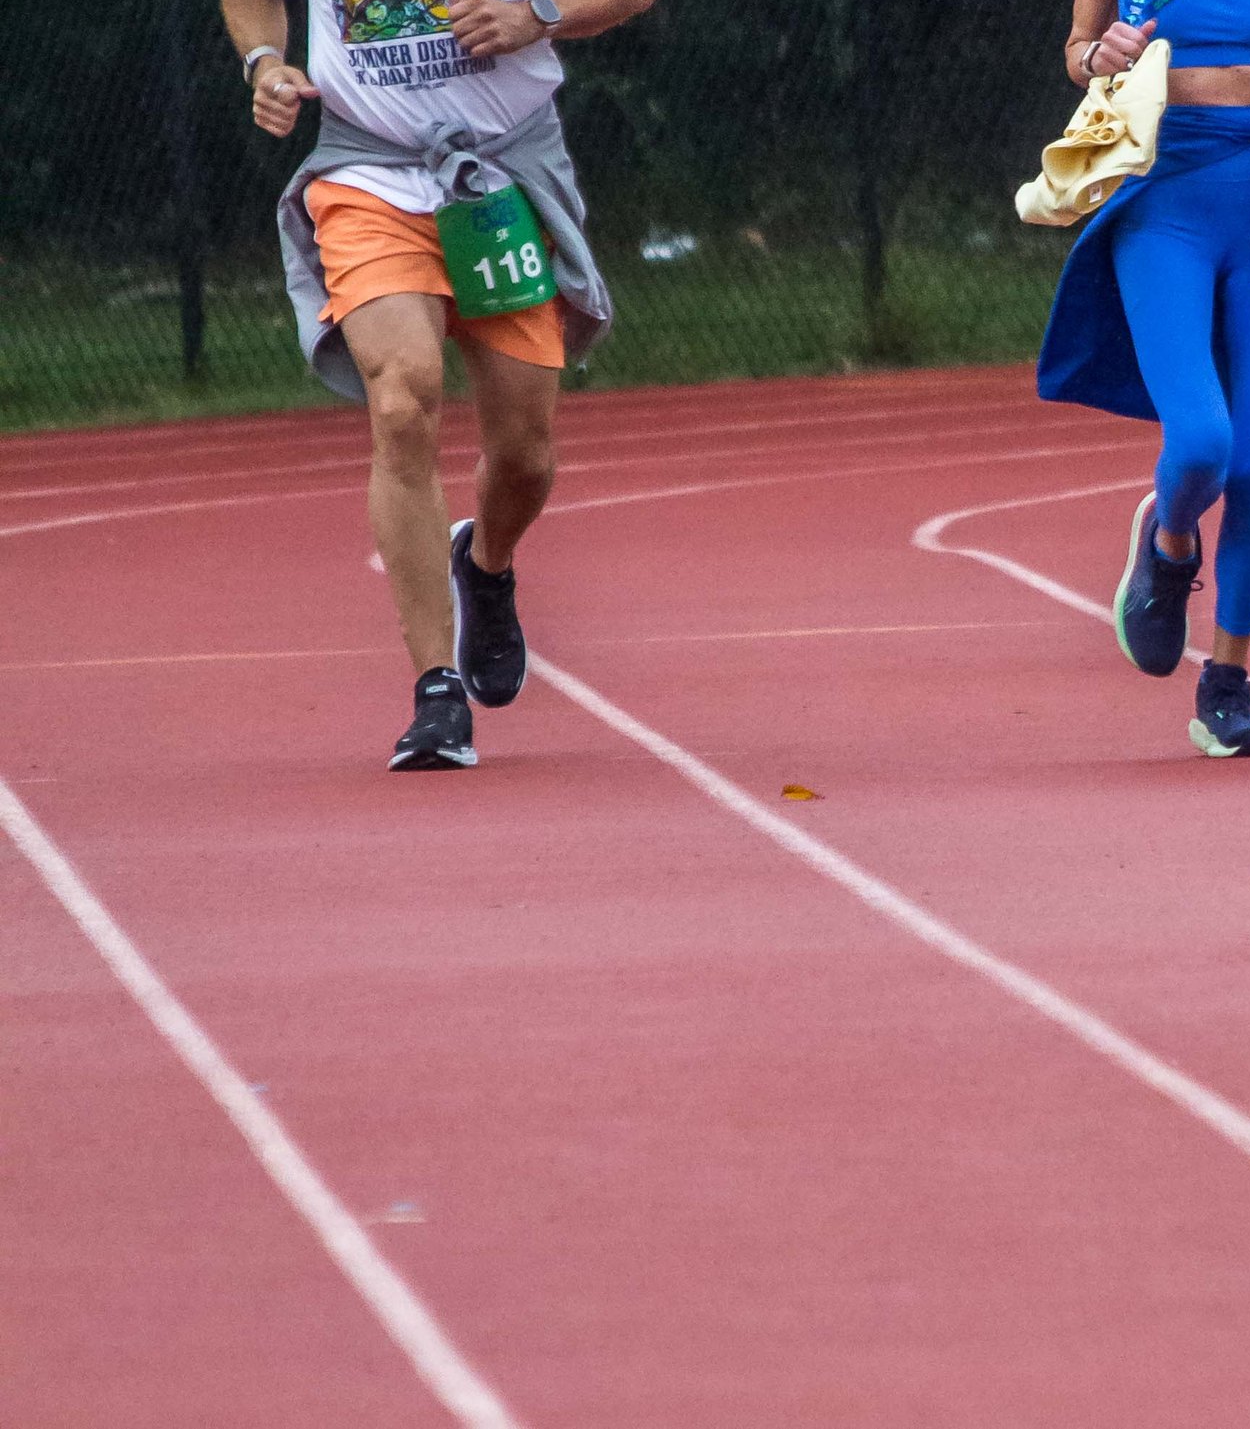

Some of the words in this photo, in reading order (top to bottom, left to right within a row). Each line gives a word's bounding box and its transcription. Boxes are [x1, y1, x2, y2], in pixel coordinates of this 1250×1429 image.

[379, 65, 413, 87] HALF
[416, 56, 497, 83] MARATHON
[473, 242, 542, 290] 118
